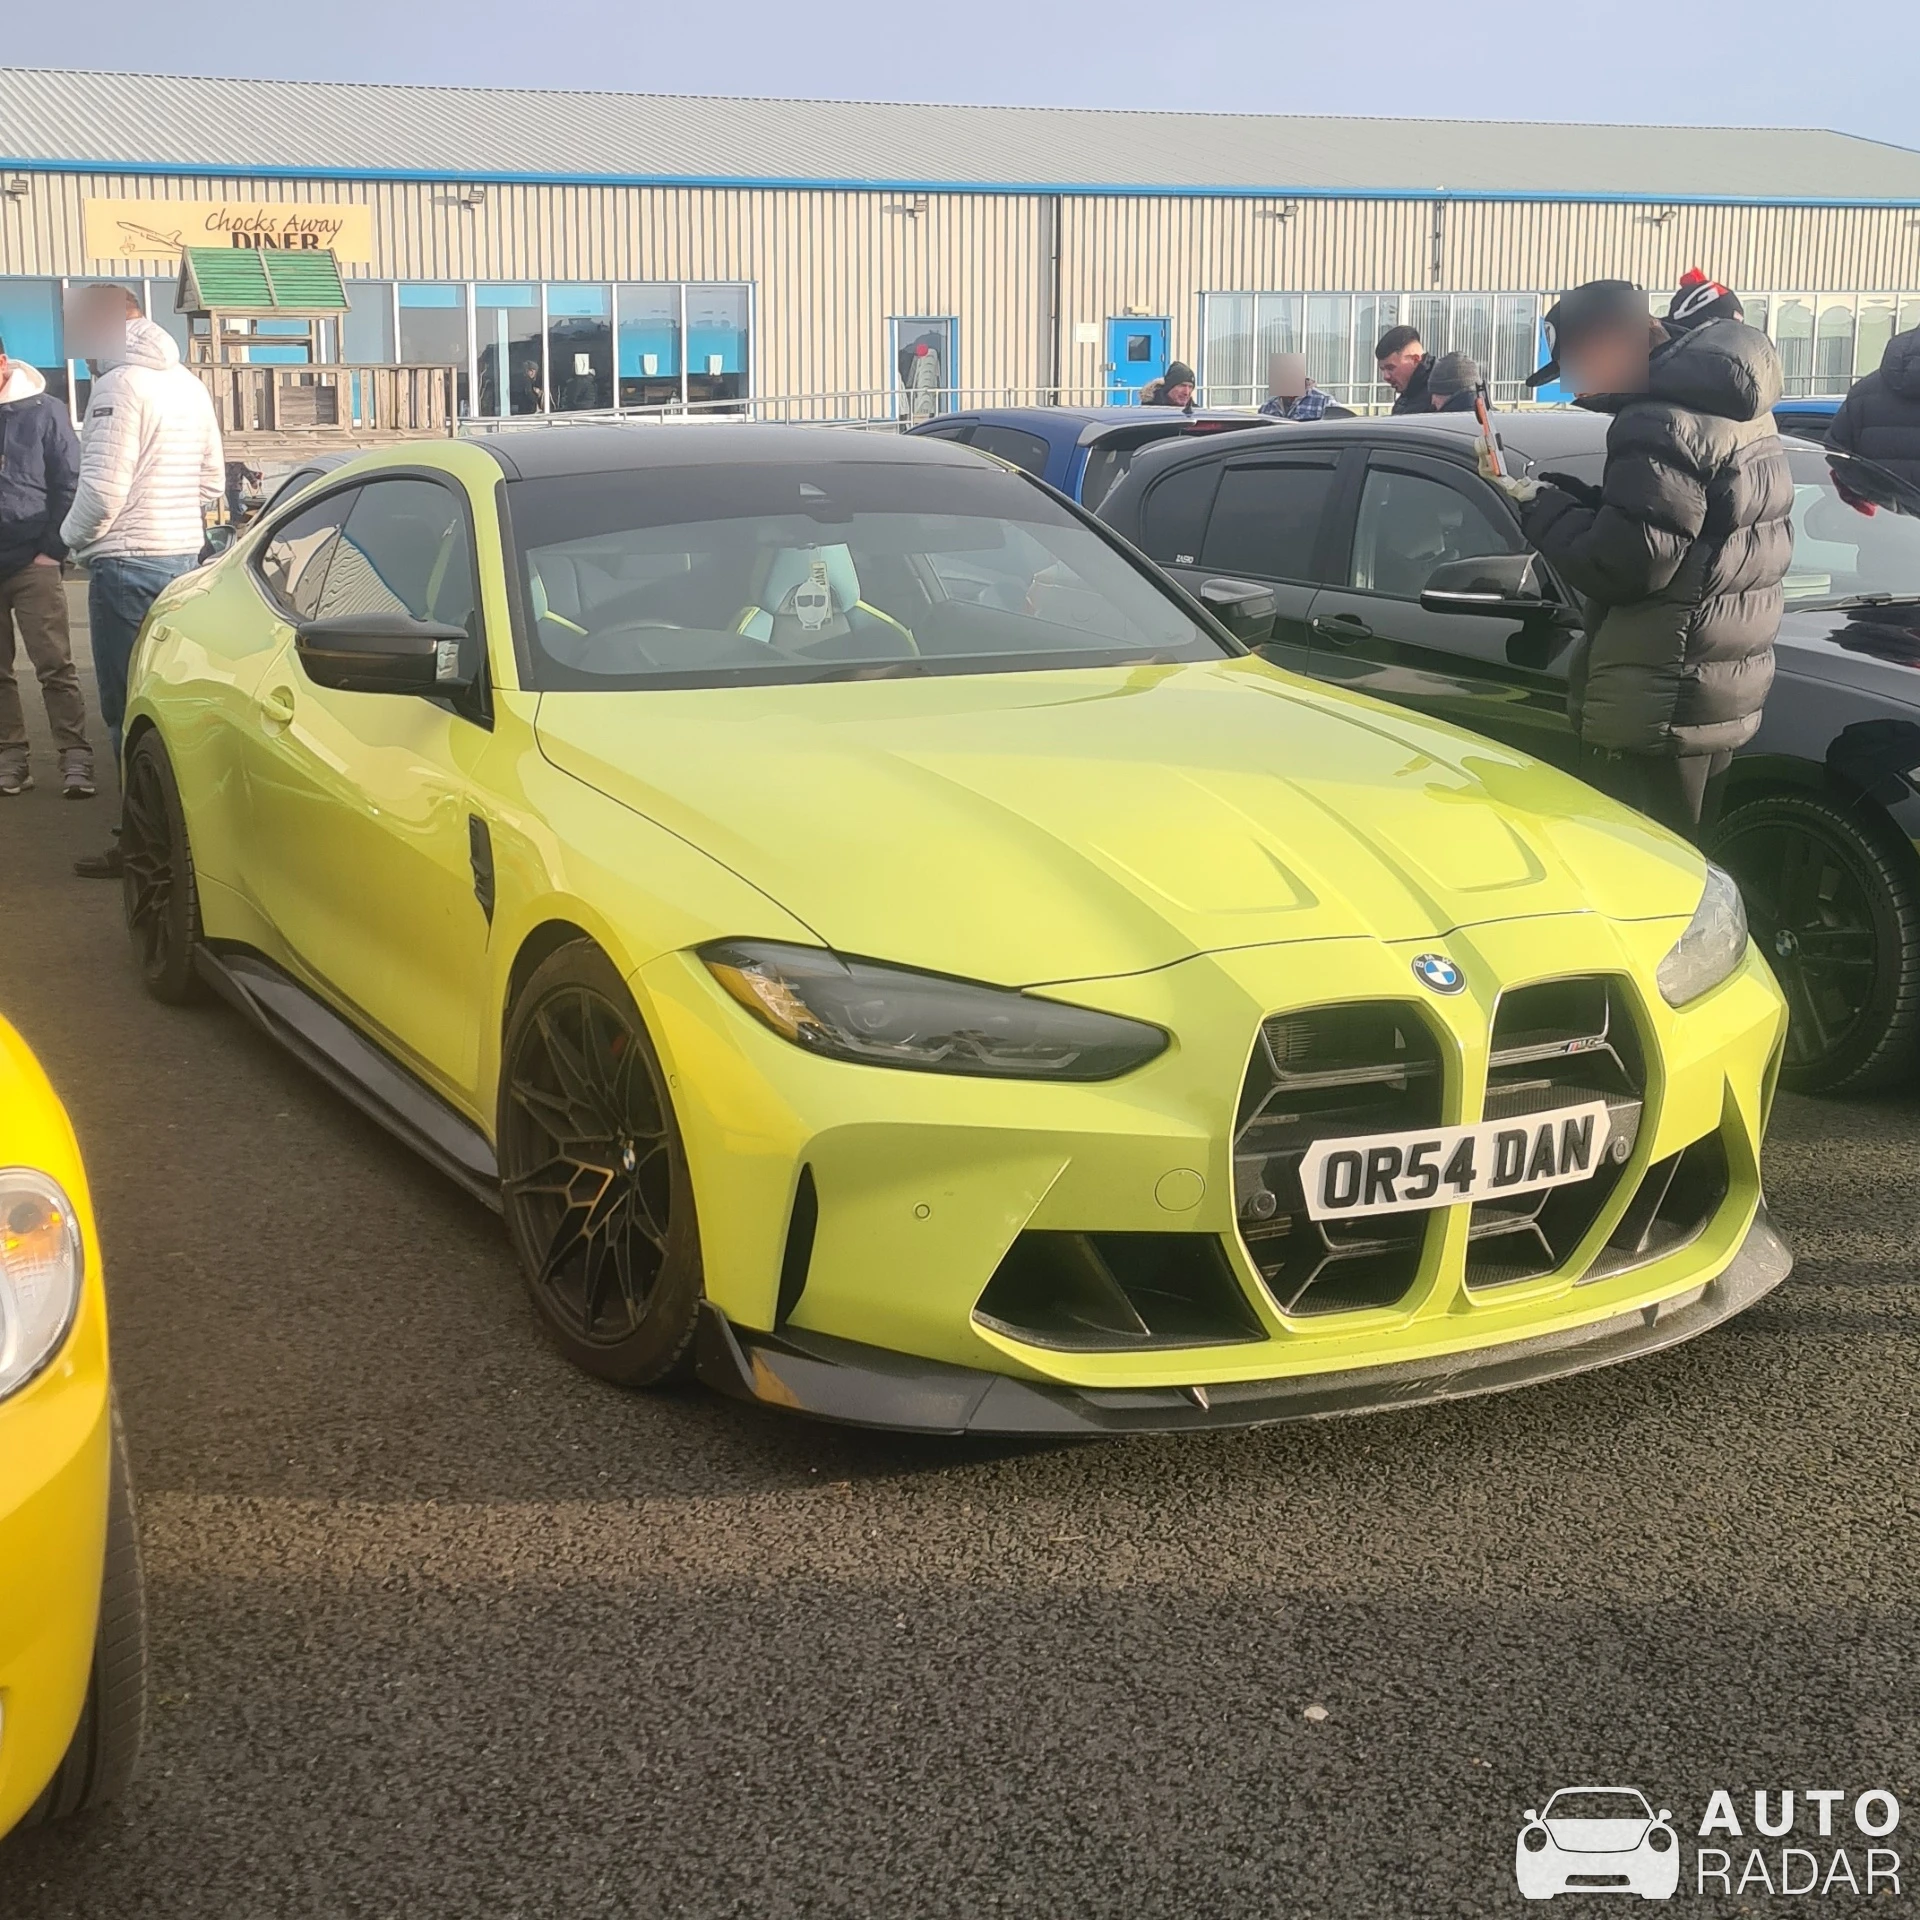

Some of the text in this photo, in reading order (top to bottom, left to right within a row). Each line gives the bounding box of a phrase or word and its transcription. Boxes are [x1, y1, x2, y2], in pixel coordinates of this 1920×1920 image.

[205, 208, 343, 245] Chocks Away
[232, 232, 319, 249] DINER
[1415, 954, 1452, 969] BMW
[1319, 1114, 1595, 1209] OR54 DAN
